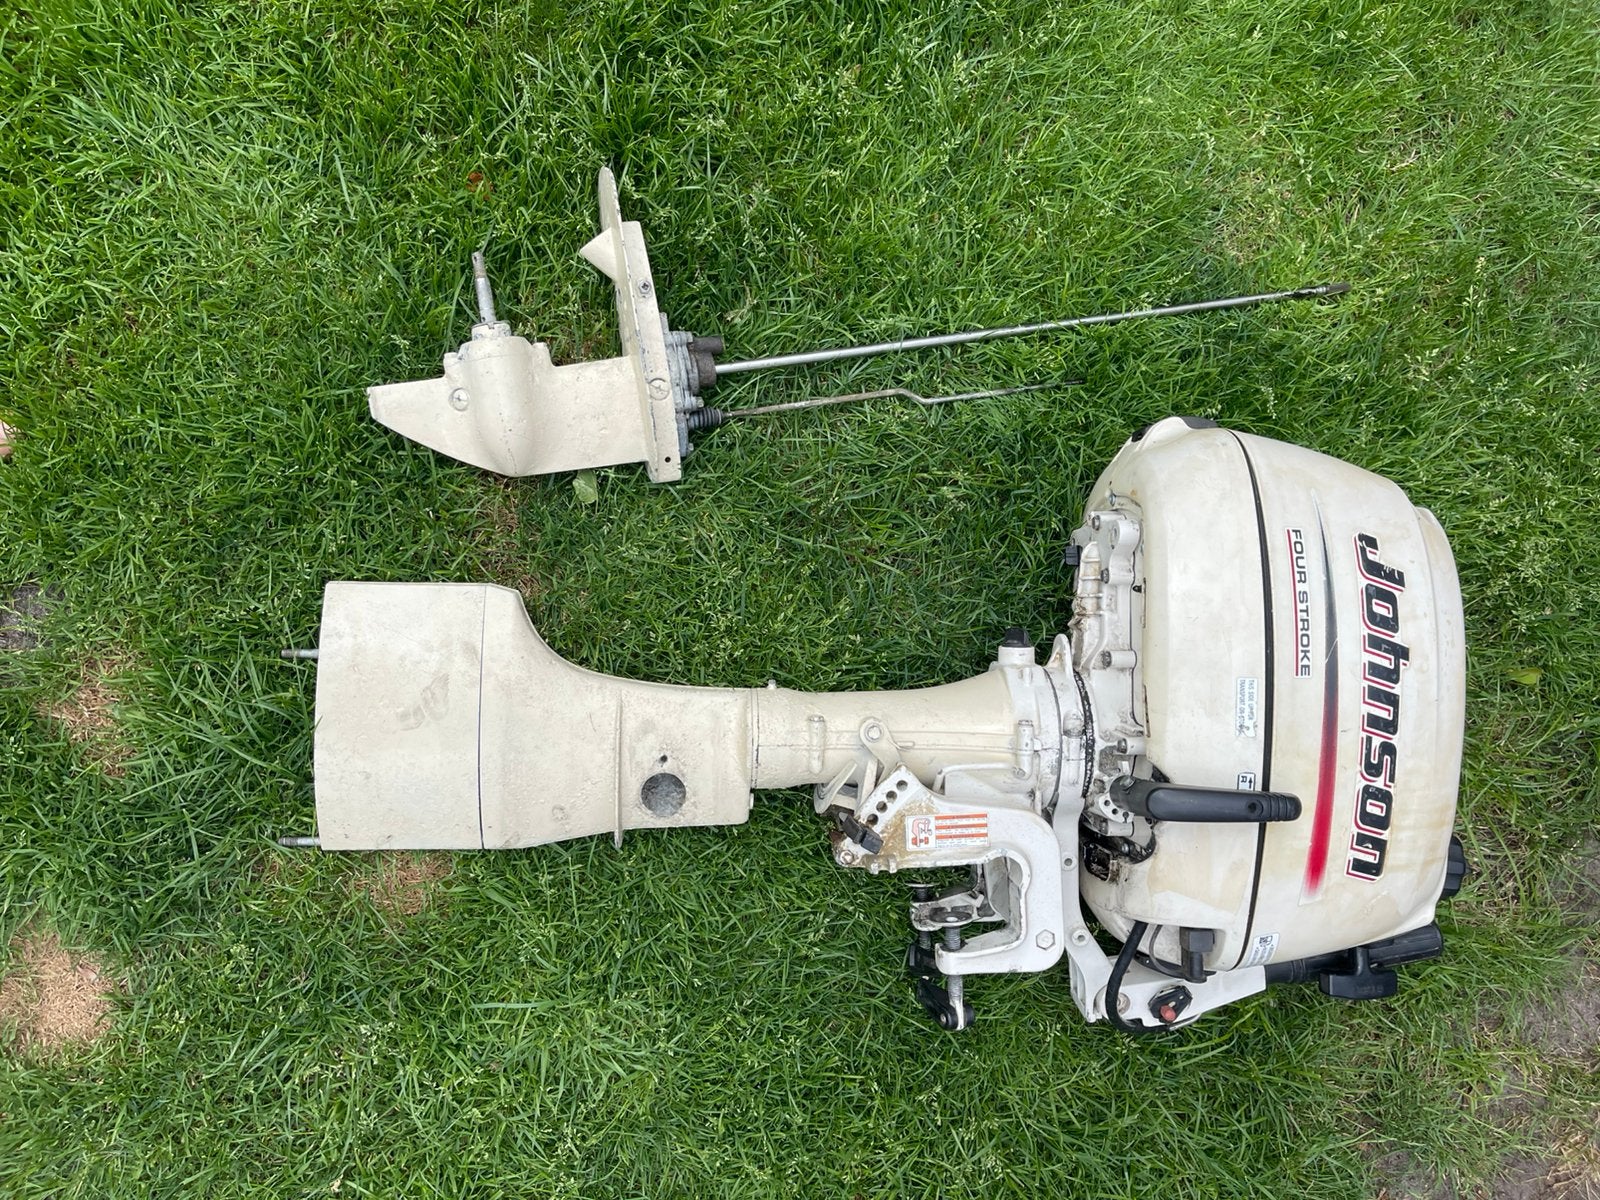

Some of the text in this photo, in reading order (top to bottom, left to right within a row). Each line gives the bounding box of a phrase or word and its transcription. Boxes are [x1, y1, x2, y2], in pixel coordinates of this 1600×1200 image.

[1292, 529, 1311, 677] FOUR STROKE
[1241, 775, 1248, 784] R
[1346, 532, 1410, 881] Johnson
